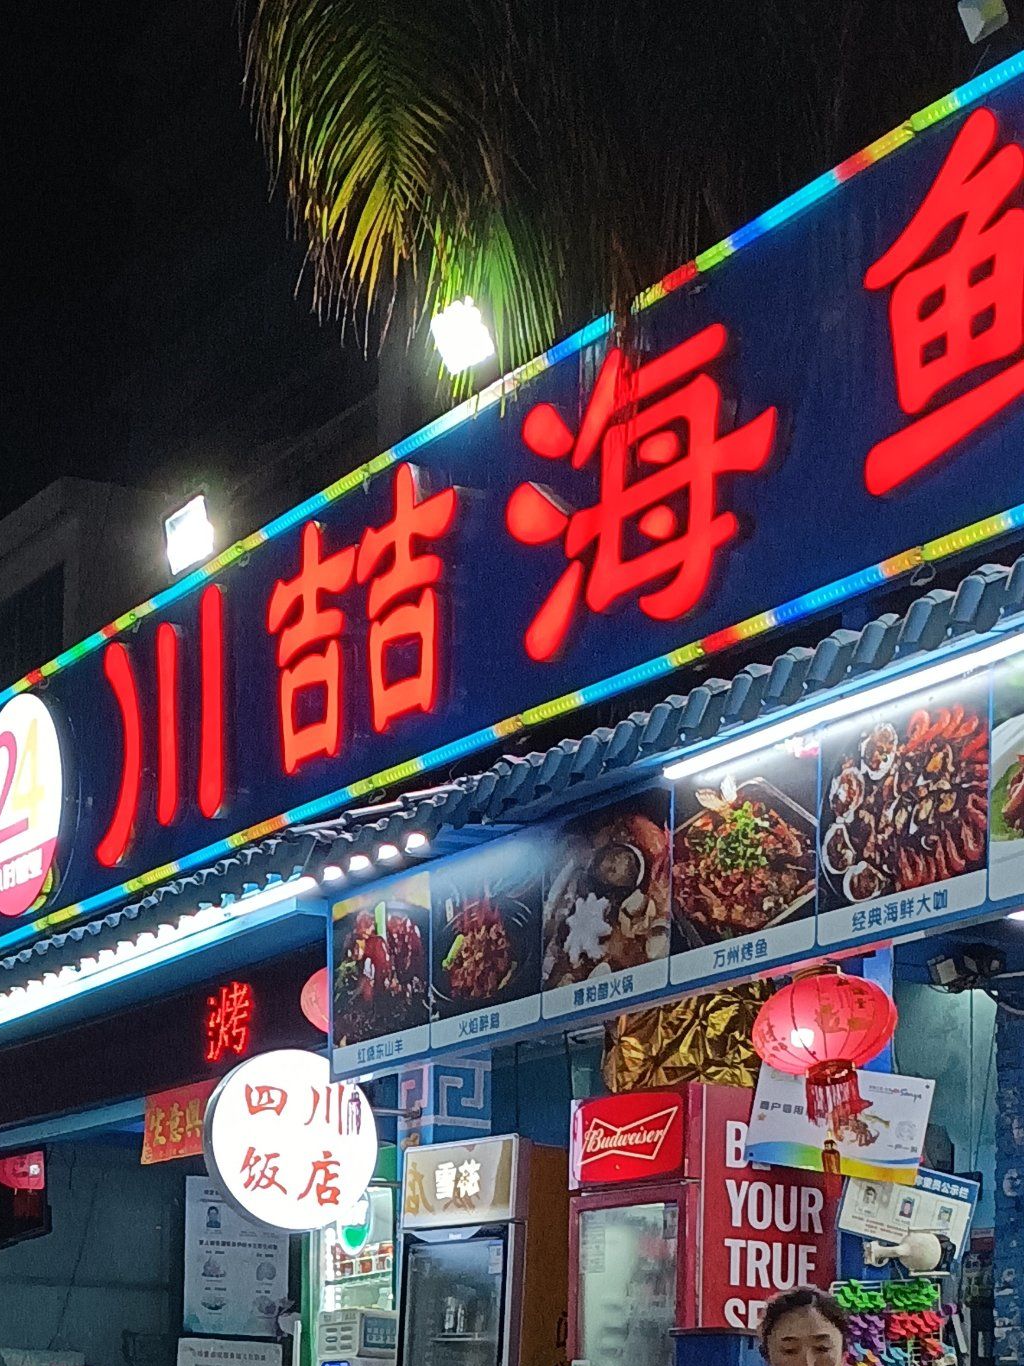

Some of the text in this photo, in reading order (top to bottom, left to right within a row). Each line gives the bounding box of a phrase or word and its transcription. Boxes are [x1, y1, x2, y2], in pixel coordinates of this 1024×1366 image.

[851, 888, 949, 933] 经典海鲜大咖
[713, 939, 768, 969] 万州烤鱼
[356, 1038, 404, 1065] 红烧东山羊
[244, 1083, 345, 1136] 四川
[584, 1125, 665, 1153] Budweiser
[239, 1145, 342, 1207] 饭店
[725, 1178, 824, 1235] YOUR
[724, 1237, 818, 1291] TRUE
